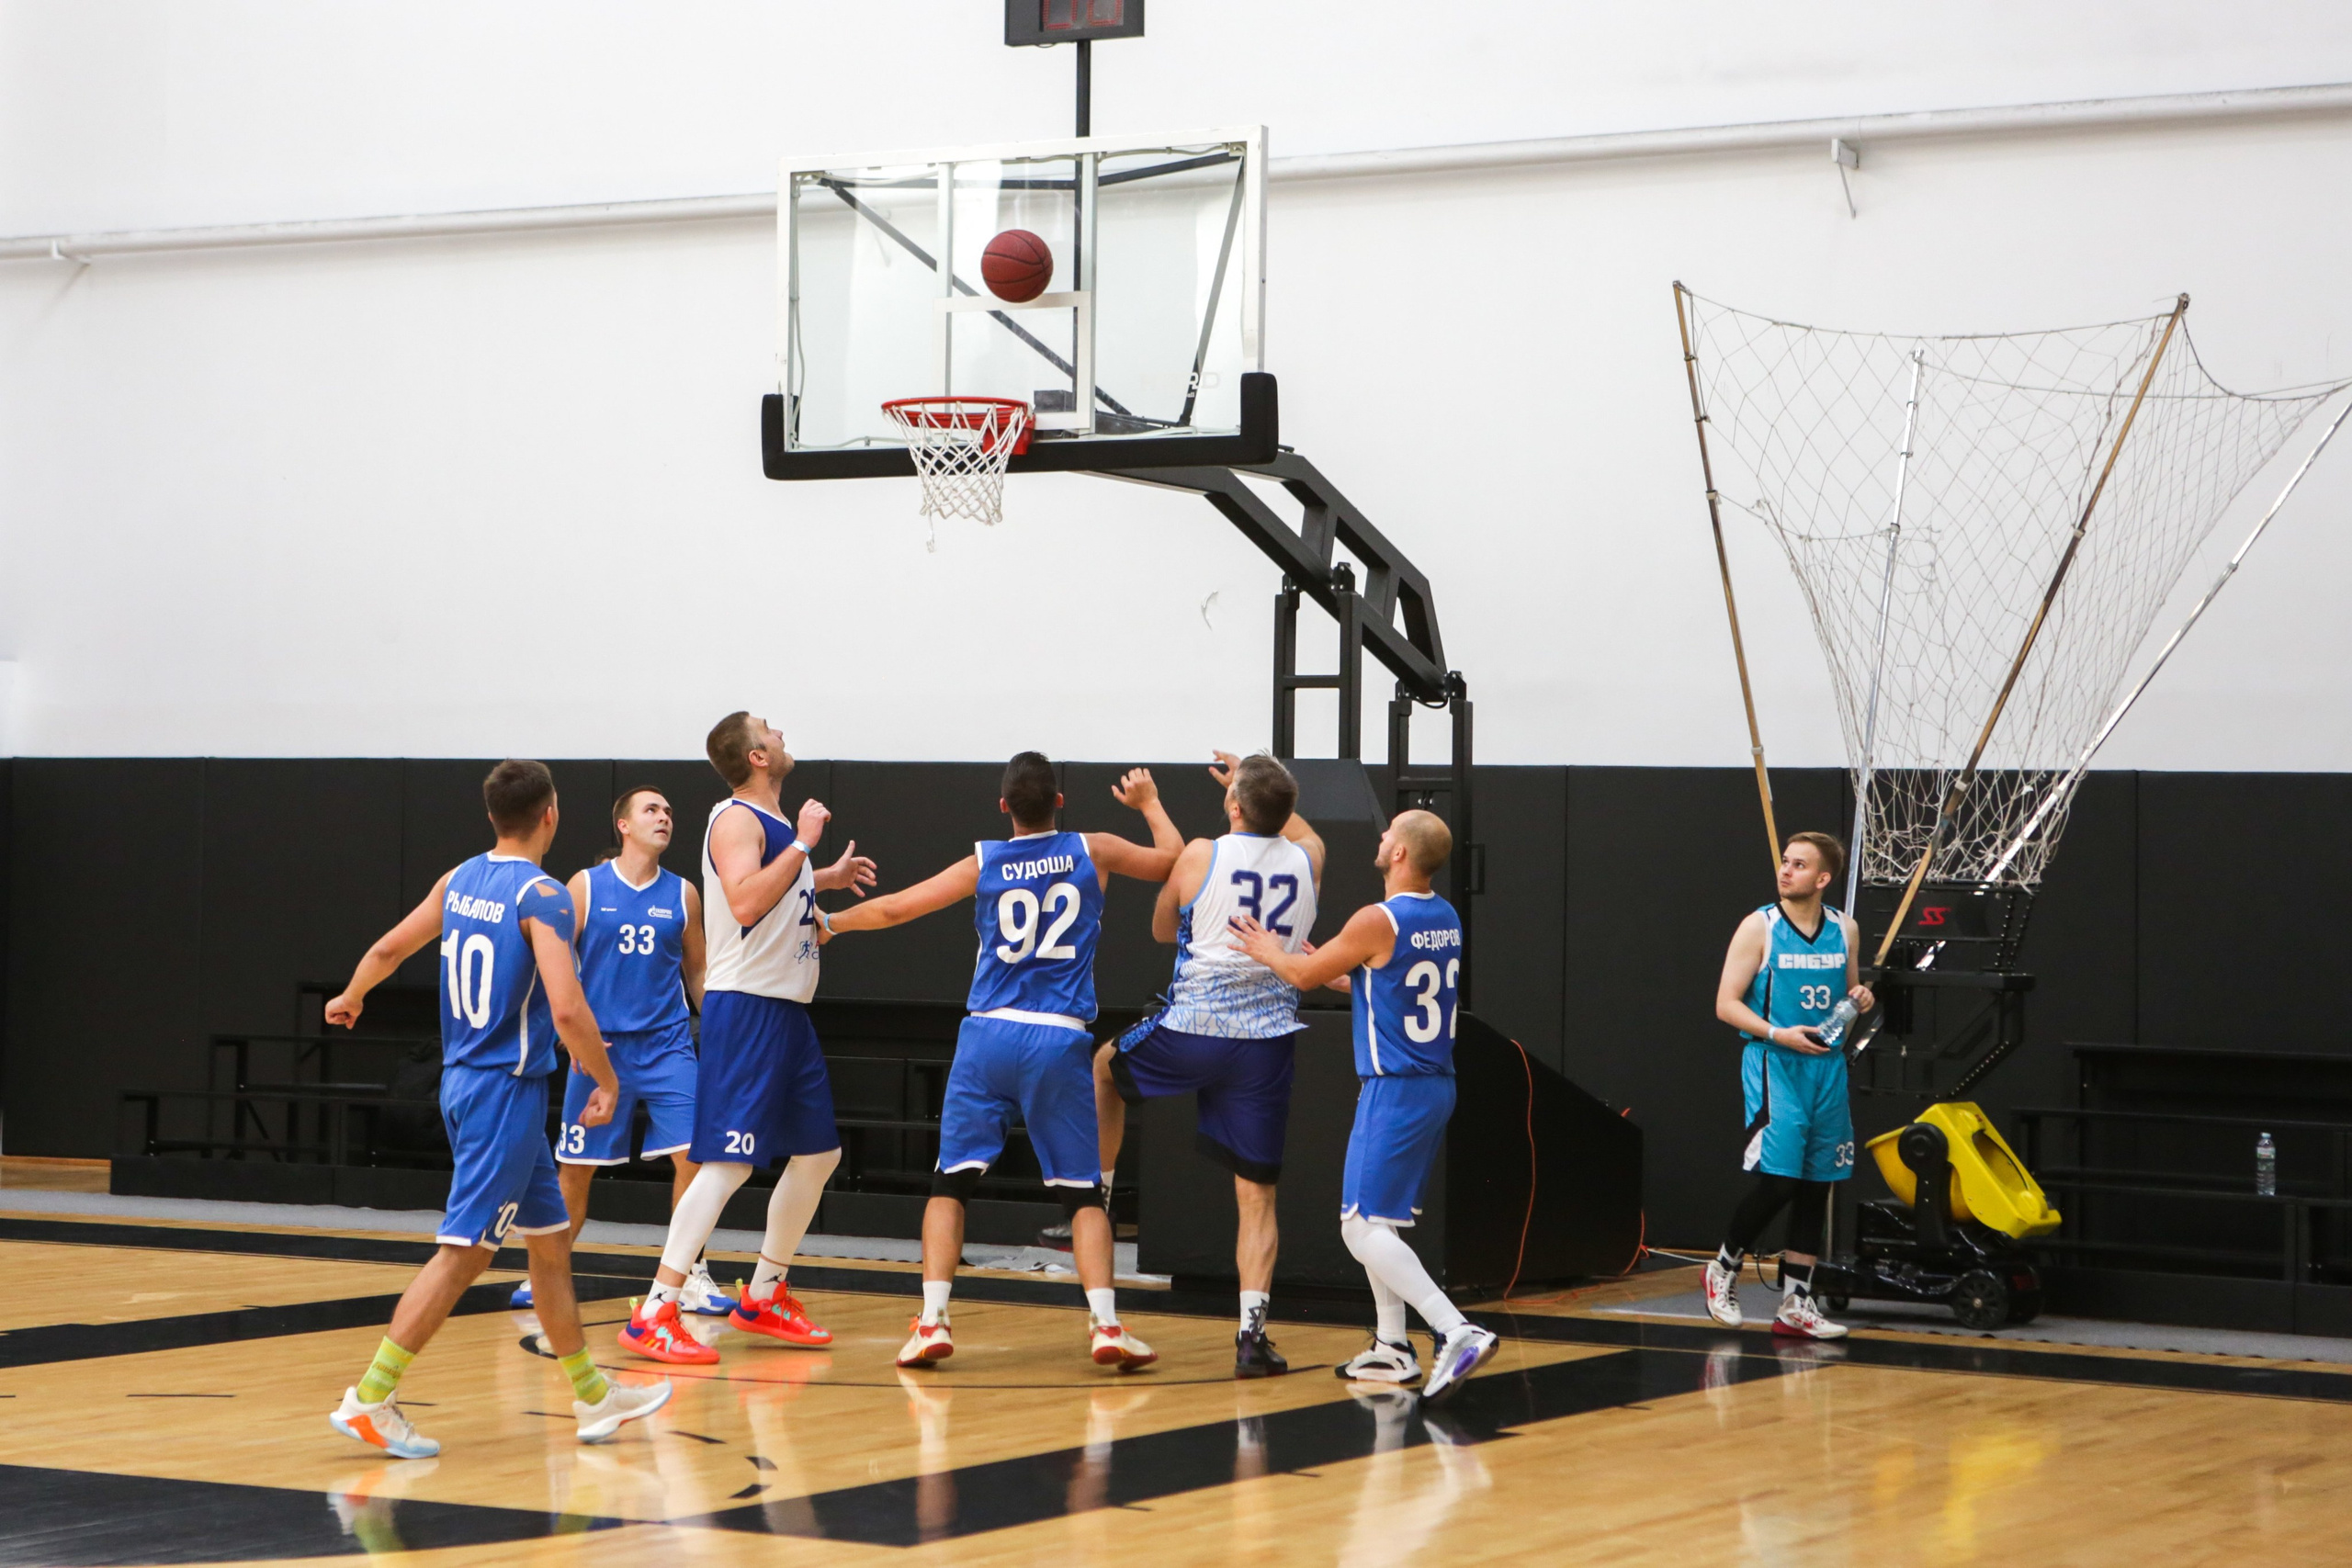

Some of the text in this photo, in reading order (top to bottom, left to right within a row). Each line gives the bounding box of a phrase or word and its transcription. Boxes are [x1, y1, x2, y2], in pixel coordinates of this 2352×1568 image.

[1001, 855, 1074, 881] СУДОША
[446, 890, 504, 924] РЫБАЛОВ
[799, 888, 815, 926] 2
[1228, 869, 1298, 937] 32
[997, 883, 1080, 964] 92
[618, 924, 655, 954] 33
[1410, 929, 1460, 951] ФЕДОРОВ
[1779, 953, 1846, 969] СИБУР
[440, 929, 494, 1029] 10
[1800, 985, 1831, 1010] 33
[560, 1122, 585, 1154] 33
[725, 1131, 754, 1155] 20
[1836, 1142, 1854, 1168] 33
